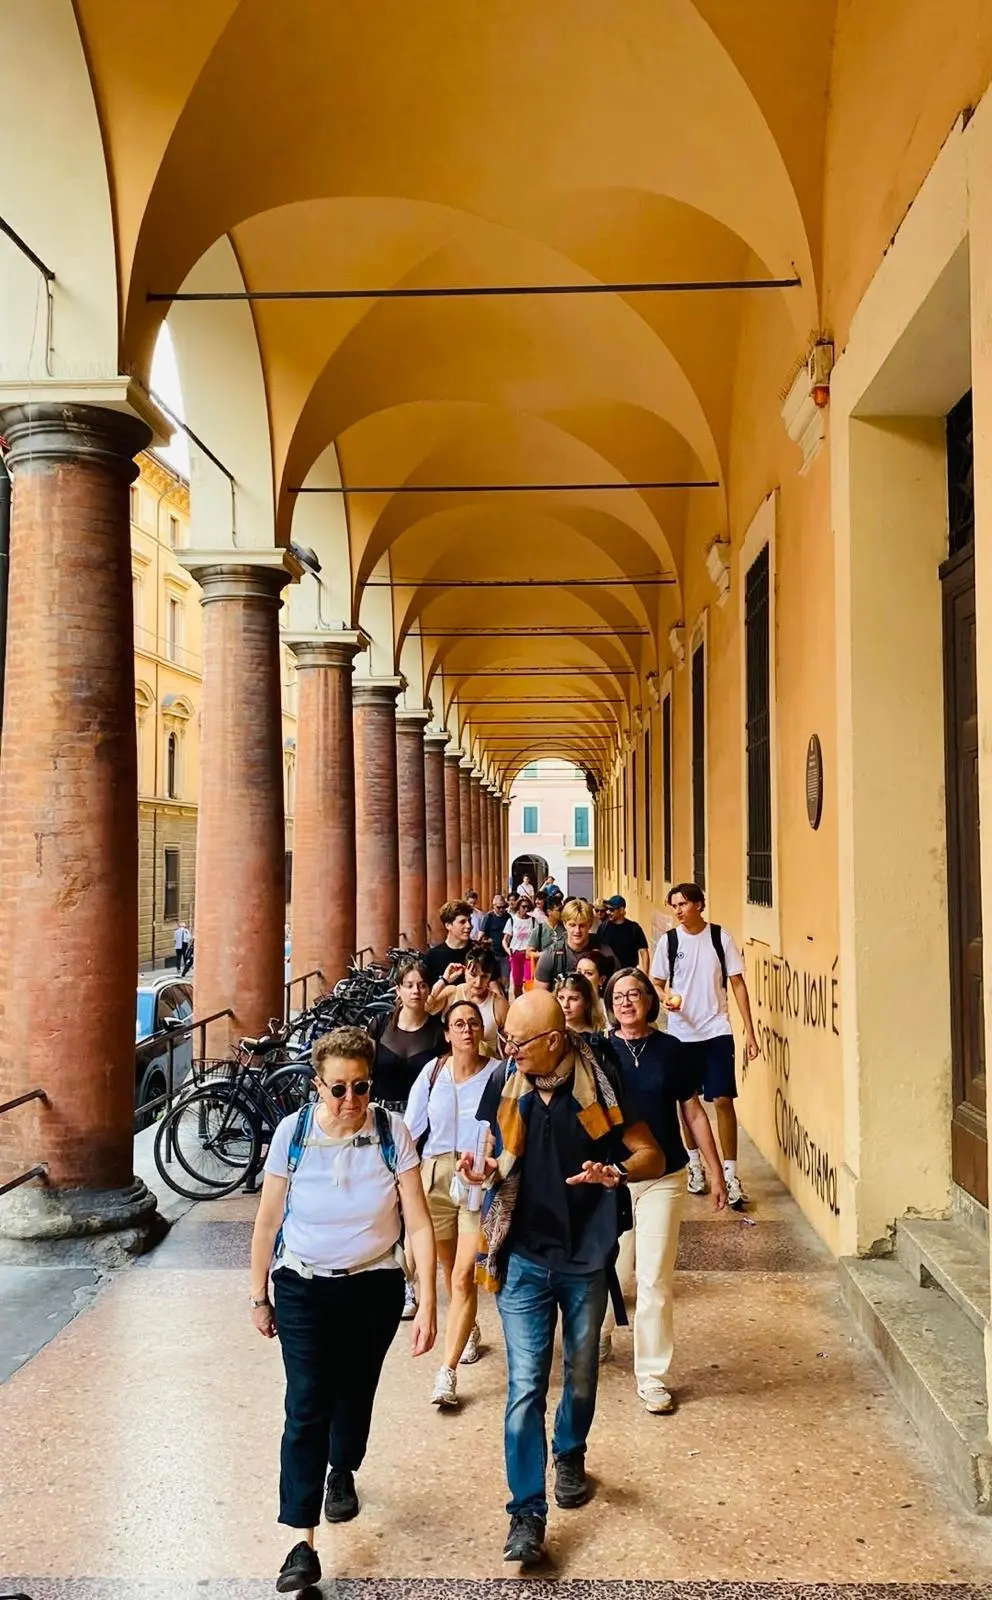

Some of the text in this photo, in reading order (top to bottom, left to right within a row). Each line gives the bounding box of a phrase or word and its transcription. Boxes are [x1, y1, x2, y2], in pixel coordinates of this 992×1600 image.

[754, 957, 762, 1006] IL
[763, 958, 800, 1020] FUTURO
[803, 970, 827, 1029] NON
[757, 1019, 790, 1081] SCRITTO
